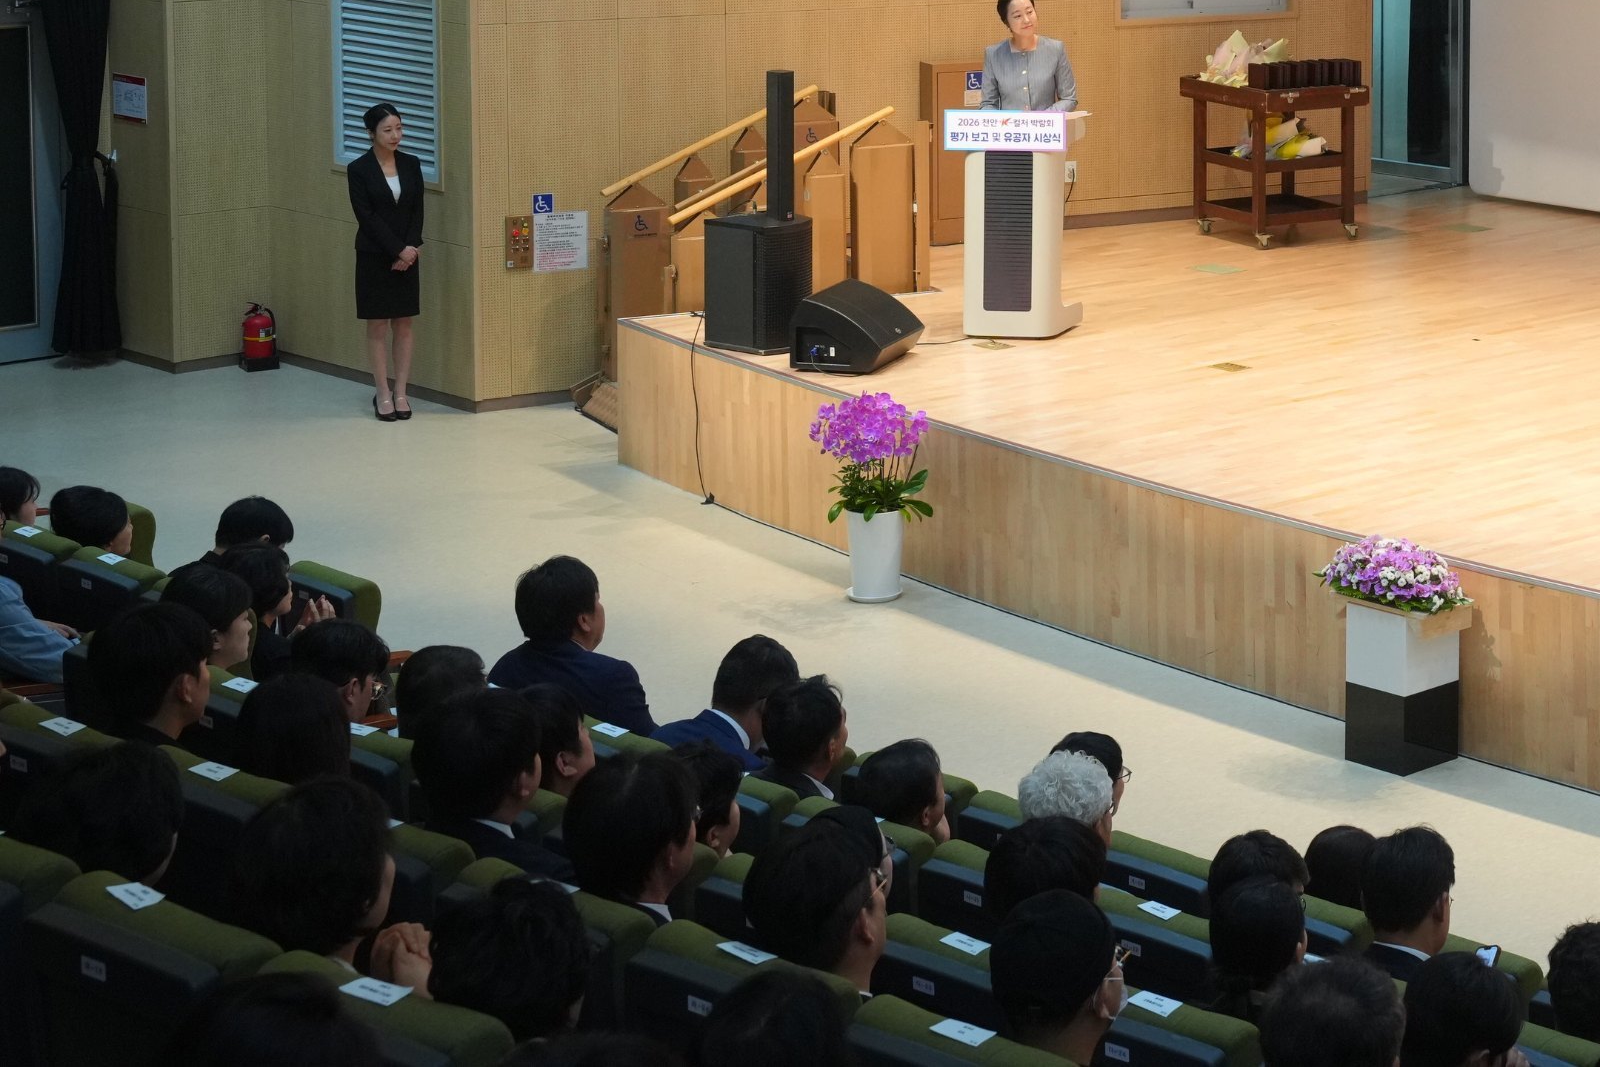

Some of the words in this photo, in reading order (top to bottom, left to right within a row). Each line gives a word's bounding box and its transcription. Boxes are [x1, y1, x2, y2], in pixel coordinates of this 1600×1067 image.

[957, 118, 980, 128] 2026
[982, 118, 998, 128] 천안
[1030, 118, 1054, 128] 박람회
[950, 132, 969, 142] 평가
[971, 132, 989, 142] 보고
[992, 133, 1001, 143] 및
[1003, 132, 1031, 143] 유공자
[1033, 132, 1061, 143] 시상식
